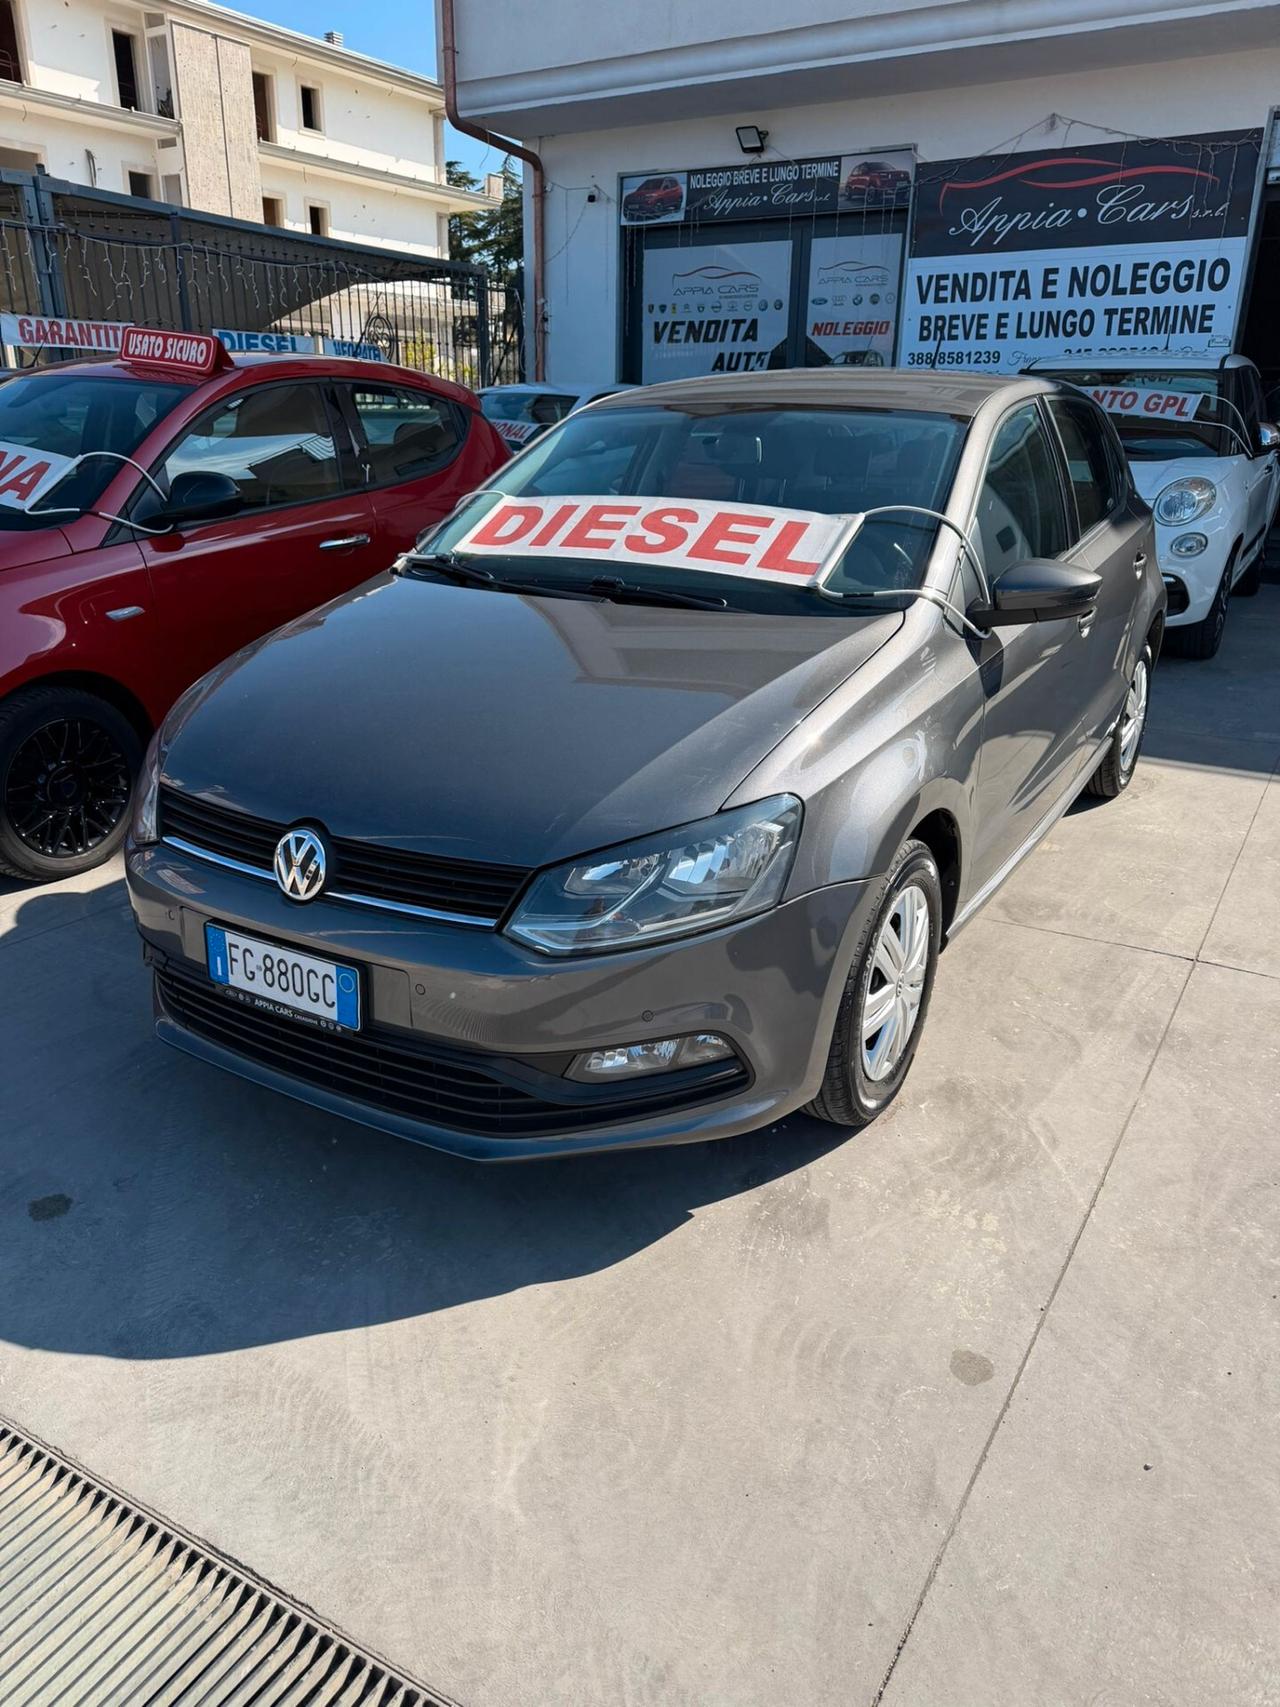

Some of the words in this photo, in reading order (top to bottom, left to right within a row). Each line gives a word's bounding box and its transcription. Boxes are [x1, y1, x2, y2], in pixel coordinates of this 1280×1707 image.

[690, 171, 732, 189] NOLEGGIO
[733, 168, 760, 185] BREVE
[762, 167, 768, 183] E
[769, 165, 799, 182] LUNGO
[801, 161, 839, 179] TERMINE
[703, 188, 761, 216] Appia
[771, 183, 815, 205] Cars
[949, 196, 1073, 247] Appia
[1096, 184, 1195, 224] Cars
[673, 286, 714, 296] APPIA
[717, 283, 760, 294] CARS
[916, 269, 1031, 305] VENDITA
[1041, 267, 1059, 299] E
[1068, 257, 1231, 298] NOLEGGIO
[653, 318, 758, 344] VENDITA
[811, 320, 891, 336] NOLEGGIO
[919, 313, 988, 342] BREVE
[995, 312, 1009, 340] E
[1015, 308, 1095, 339] LUNGO
[1104, 303, 1216, 337] TERMINE
[128, 333, 163, 358] USATO
[164, 337, 207, 364] SICURO
[1143, 392, 1189, 417] GPL
[469, 504, 822, 576] DIESEL
